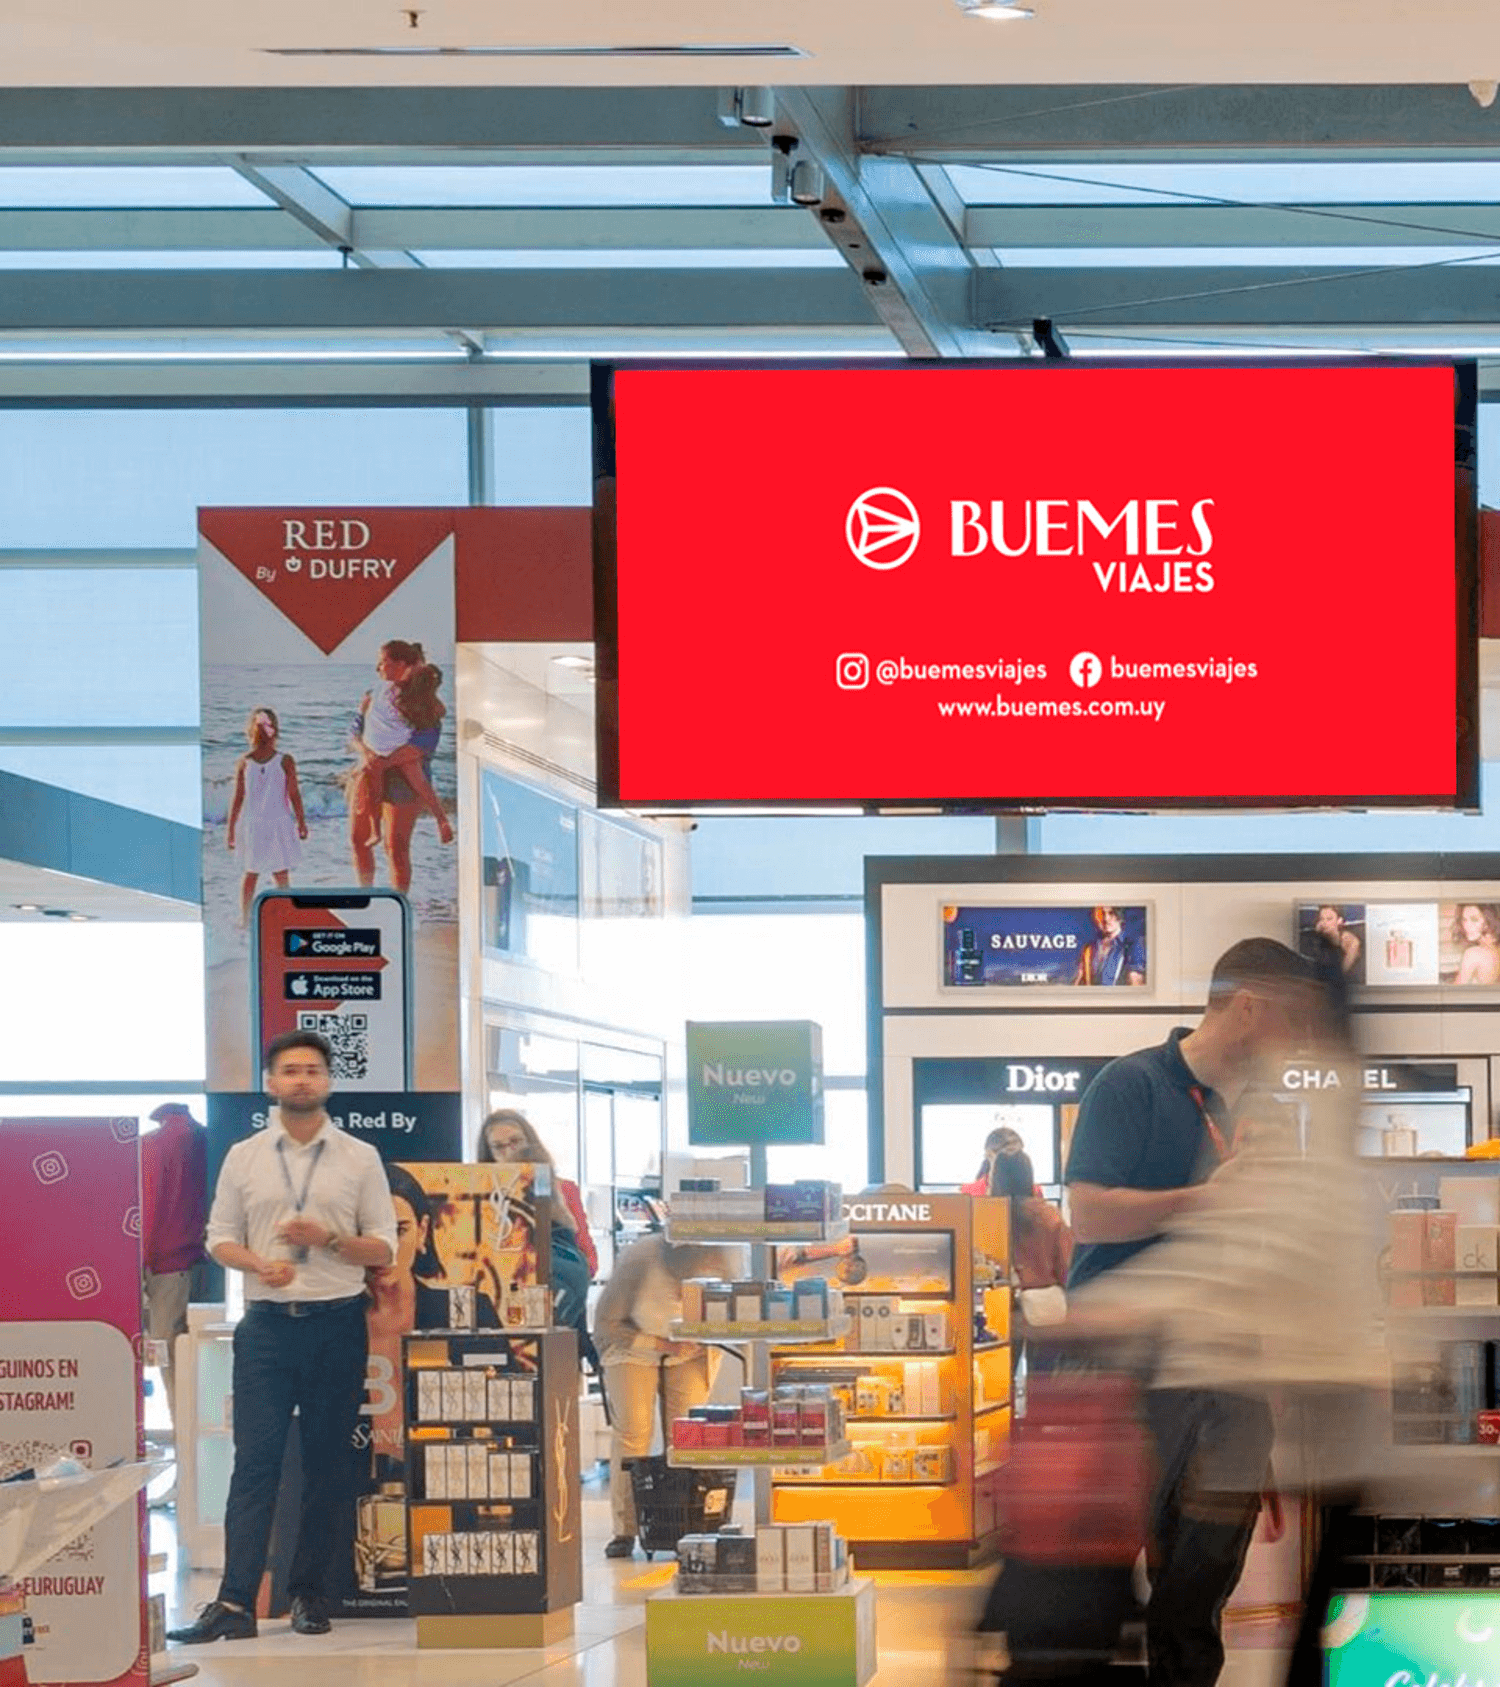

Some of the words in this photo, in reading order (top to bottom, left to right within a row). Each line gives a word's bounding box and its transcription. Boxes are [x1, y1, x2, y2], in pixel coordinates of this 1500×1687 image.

[283, 519, 370, 549] RED
[951, 499, 1214, 556] BUEMES
[255, 566, 277, 582] By
[309, 558, 396, 579] DUFRY
[1093, 562, 1214, 592] VIAJES
[877, 657, 1046, 684] @buemesviajes
[1112, 656, 1257, 683] buemesviajes
[939, 694, 1165, 721] www.buemes.com.uy
[312, 941, 352, 955] Google
[353, 942, 376, 954] Play
[991, 934, 1078, 949] SAUVAGE
[313, 983, 340, 997] App
[341, 983, 374, 996] Store
[703, 1064, 797, 1086] Nuevo
[1006, 1064, 1080, 1092] Dior
[1282, 1069, 1398, 1089] CHAEL
[349, 1112, 386, 1128] Red
[391, 1112, 417, 1133] By
[842, 1203, 932, 1221] CCITANE
[1463, 1242, 1487, 1269] ck
[0, 1359, 54, 1379] GUINOS
[59, 1359, 78, 1378] EN
[22, 1576, 104, 1595] EURUGUAY
[707, 1630, 801, 1653] Nuevo
